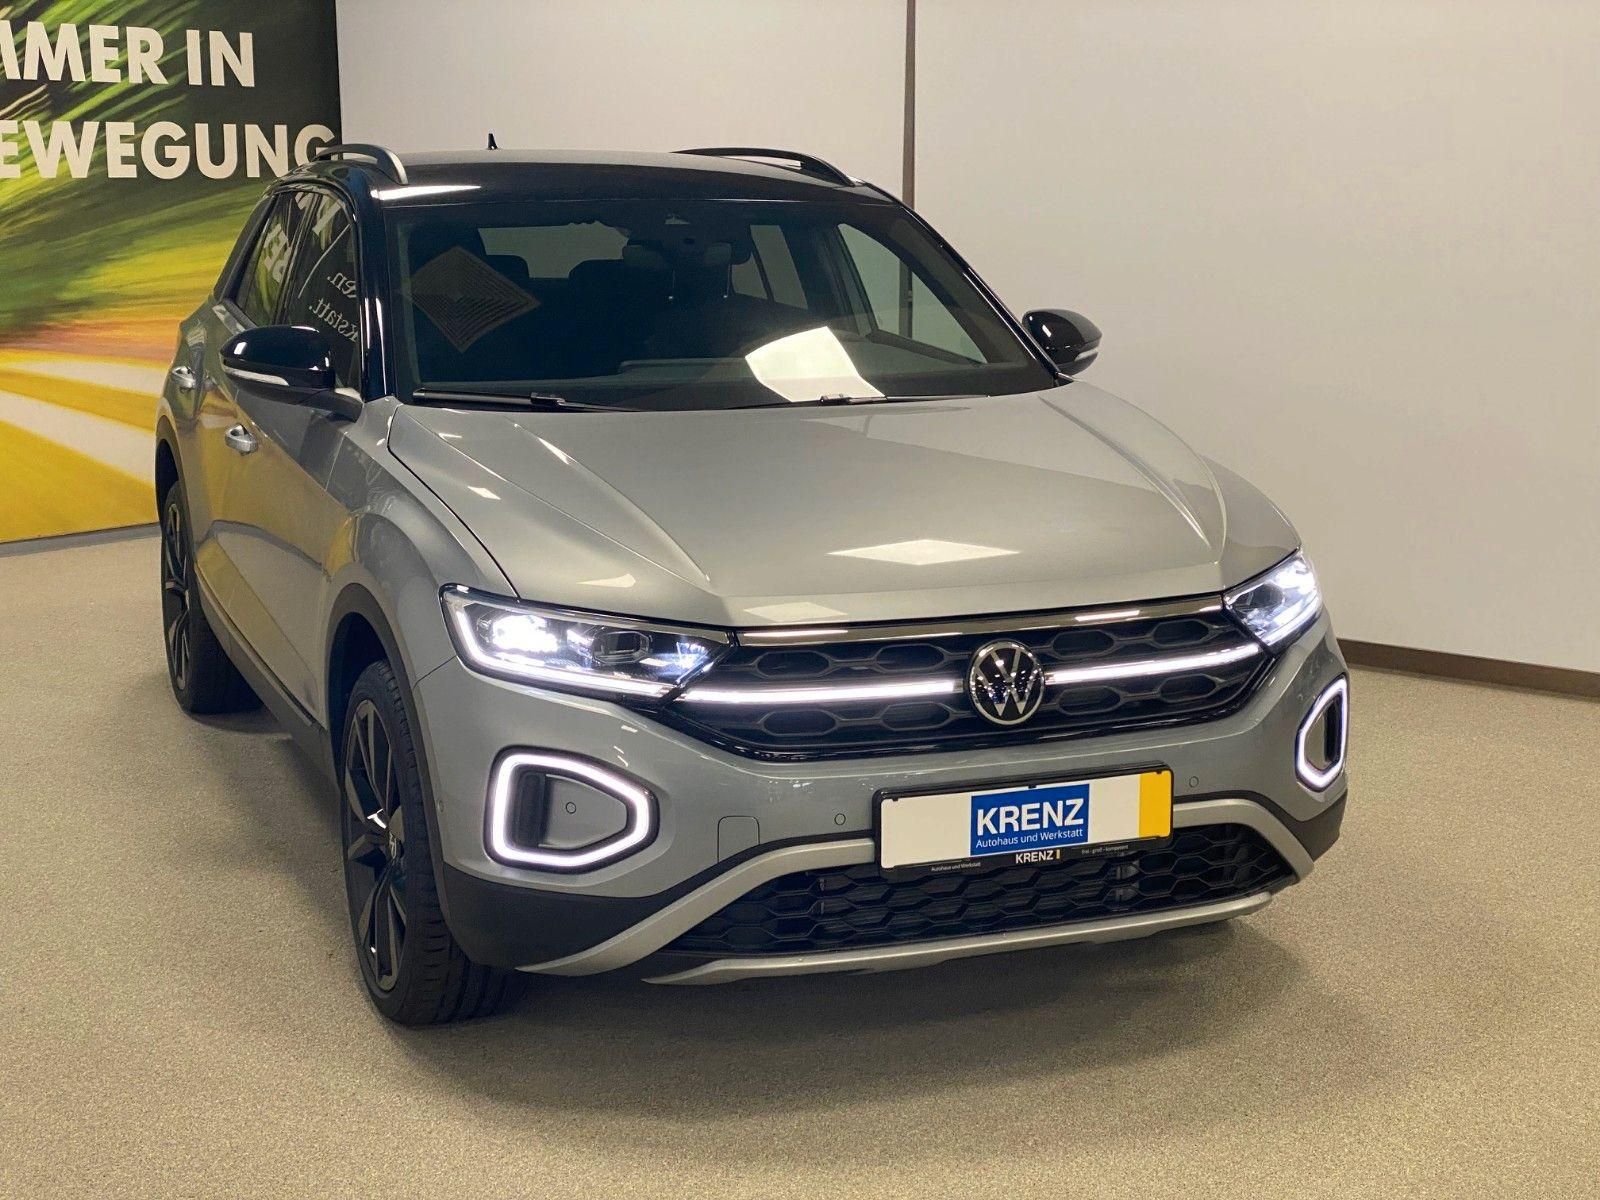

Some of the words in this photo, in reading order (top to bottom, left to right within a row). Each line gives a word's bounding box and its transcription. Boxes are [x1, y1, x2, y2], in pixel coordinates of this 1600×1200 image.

[186, 29, 255, 87] IN
[977, 798, 1084, 836] KRENZ
[975, 836, 1019, 849] Autohaus
[1020, 832, 1038, 843] und
[1040, 828, 1083, 841] Werkstatt
[1015, 850, 1054, 864] KRENZ
